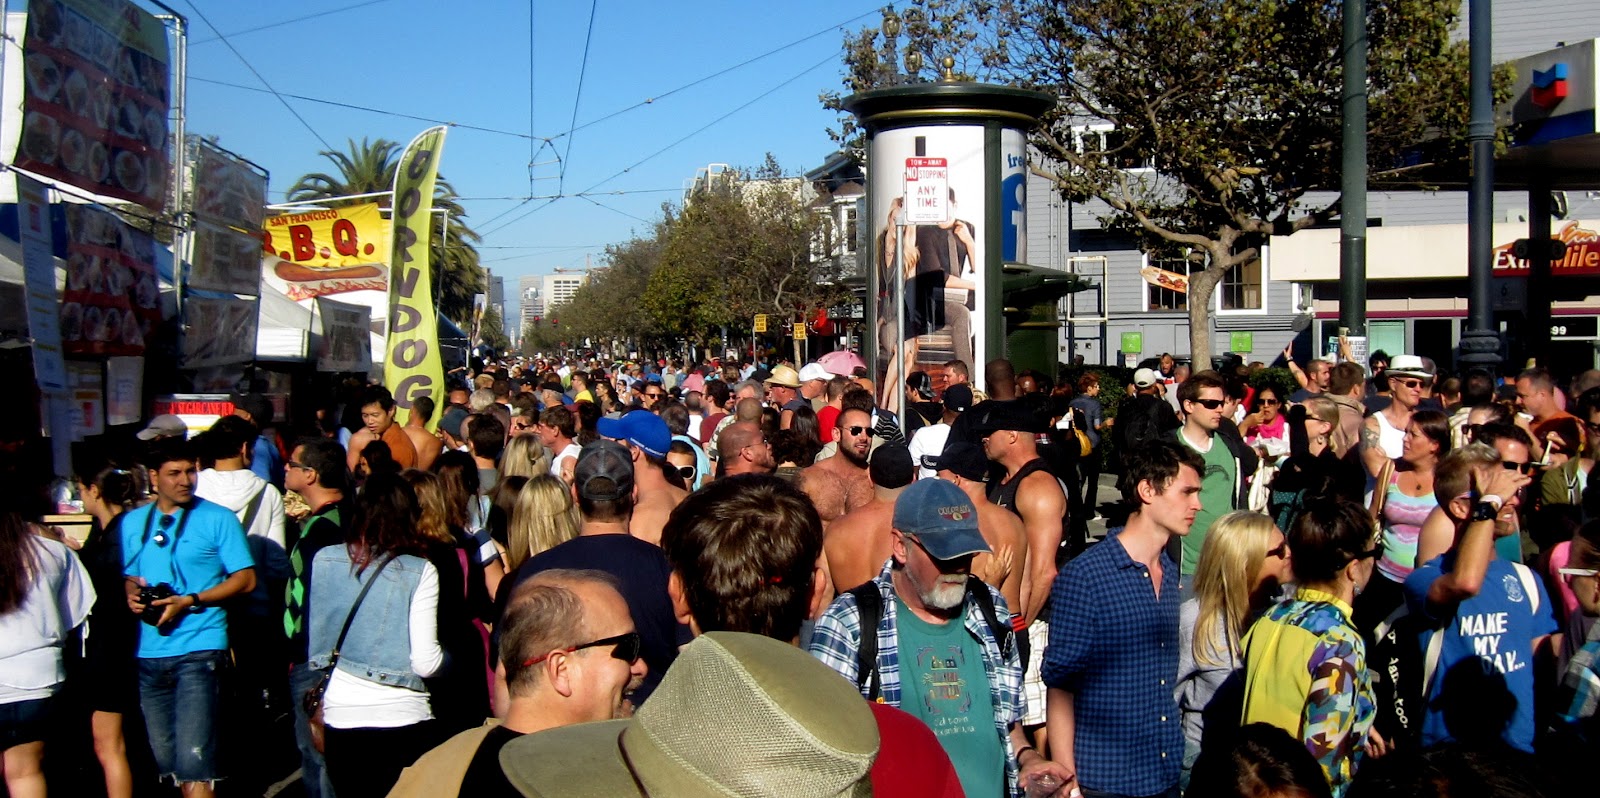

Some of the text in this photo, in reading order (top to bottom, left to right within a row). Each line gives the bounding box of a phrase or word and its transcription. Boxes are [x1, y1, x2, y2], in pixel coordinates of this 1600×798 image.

[906, 167, 946, 179] NO STOPPING
[917, 186, 937, 195] ANY
[916, 197, 938, 207] TIME
[270, 210, 338, 227] SAN FRANCISCO
[391, 150, 434, 410] CORNDOG
[1550, 325, 1567, 336] 99
[937, 504, 971, 515] COLORADO
[1460, 612, 1508, 637] MAKE
[1474, 635, 1501, 656] MY
